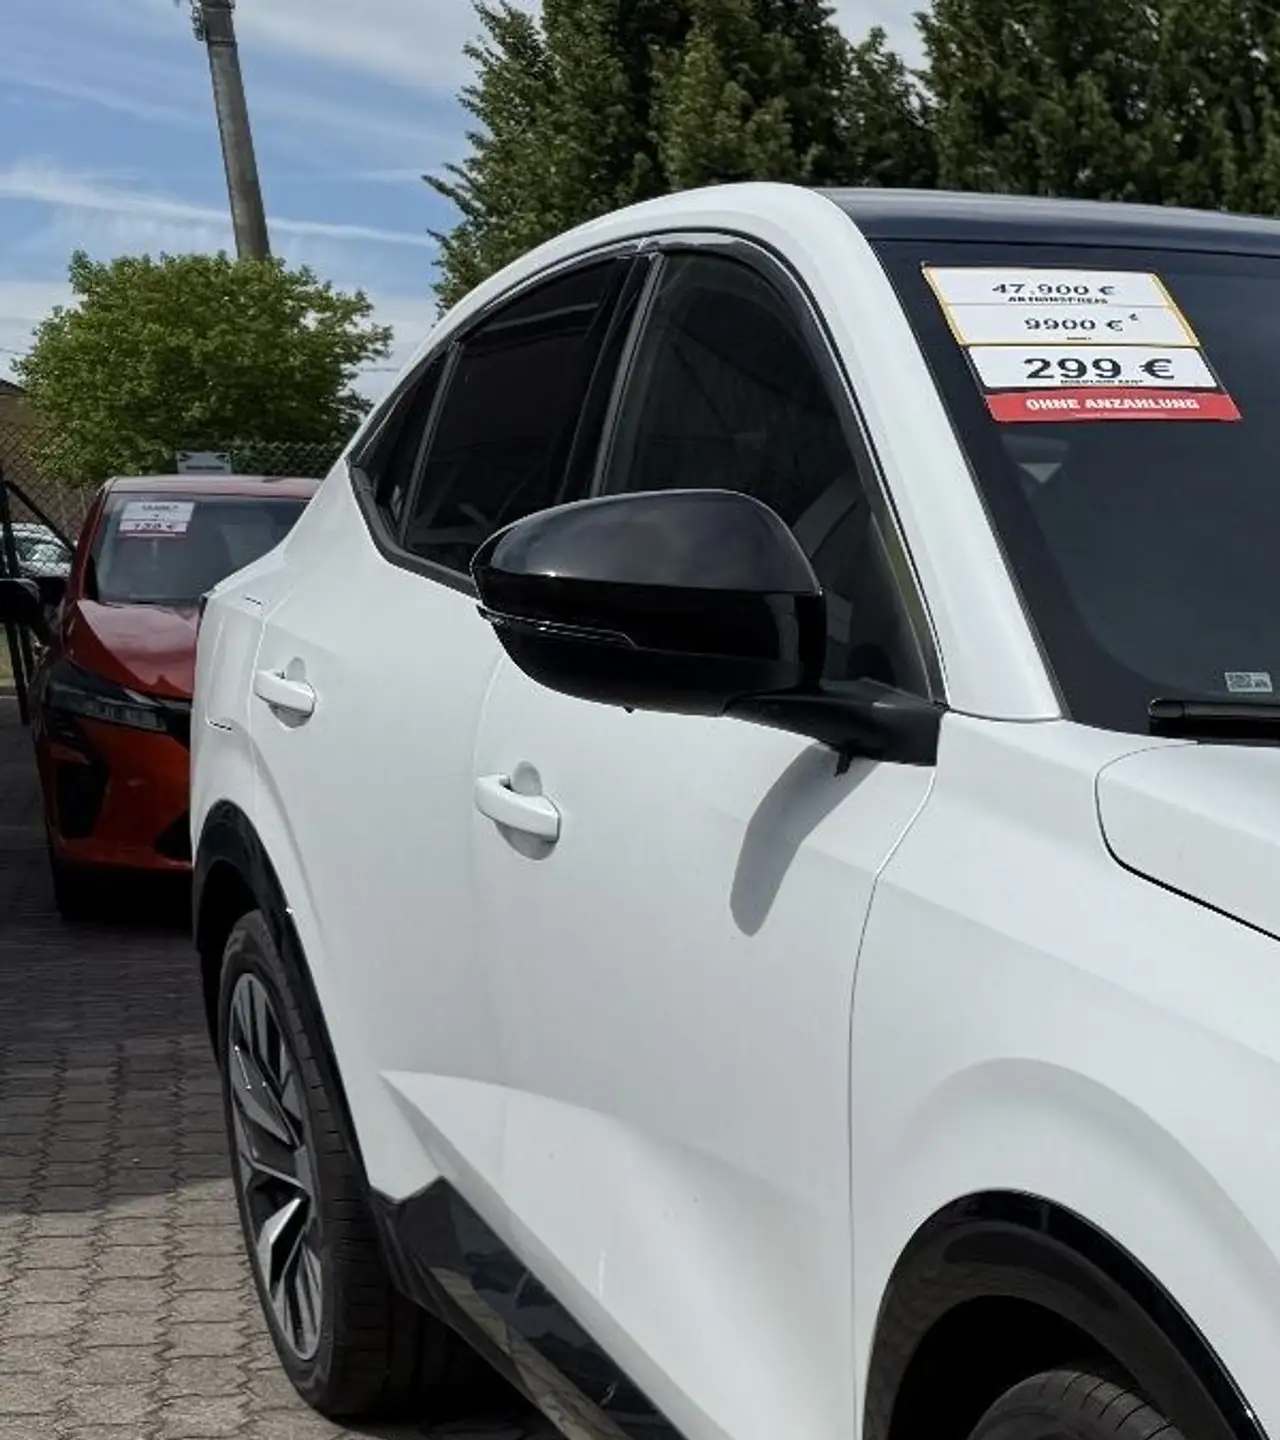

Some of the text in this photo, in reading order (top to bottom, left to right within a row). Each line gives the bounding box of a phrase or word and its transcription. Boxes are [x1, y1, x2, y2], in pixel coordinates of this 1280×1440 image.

[992, 283, 1116, 296] 47.900 €
[1024, 318, 1096, 331] 9900
[1106, 319, 1123, 332] €
[1024, 357, 1175, 379] 299 €
[1025, 397, 1200, 411] OHNE ANZAHLUNG
